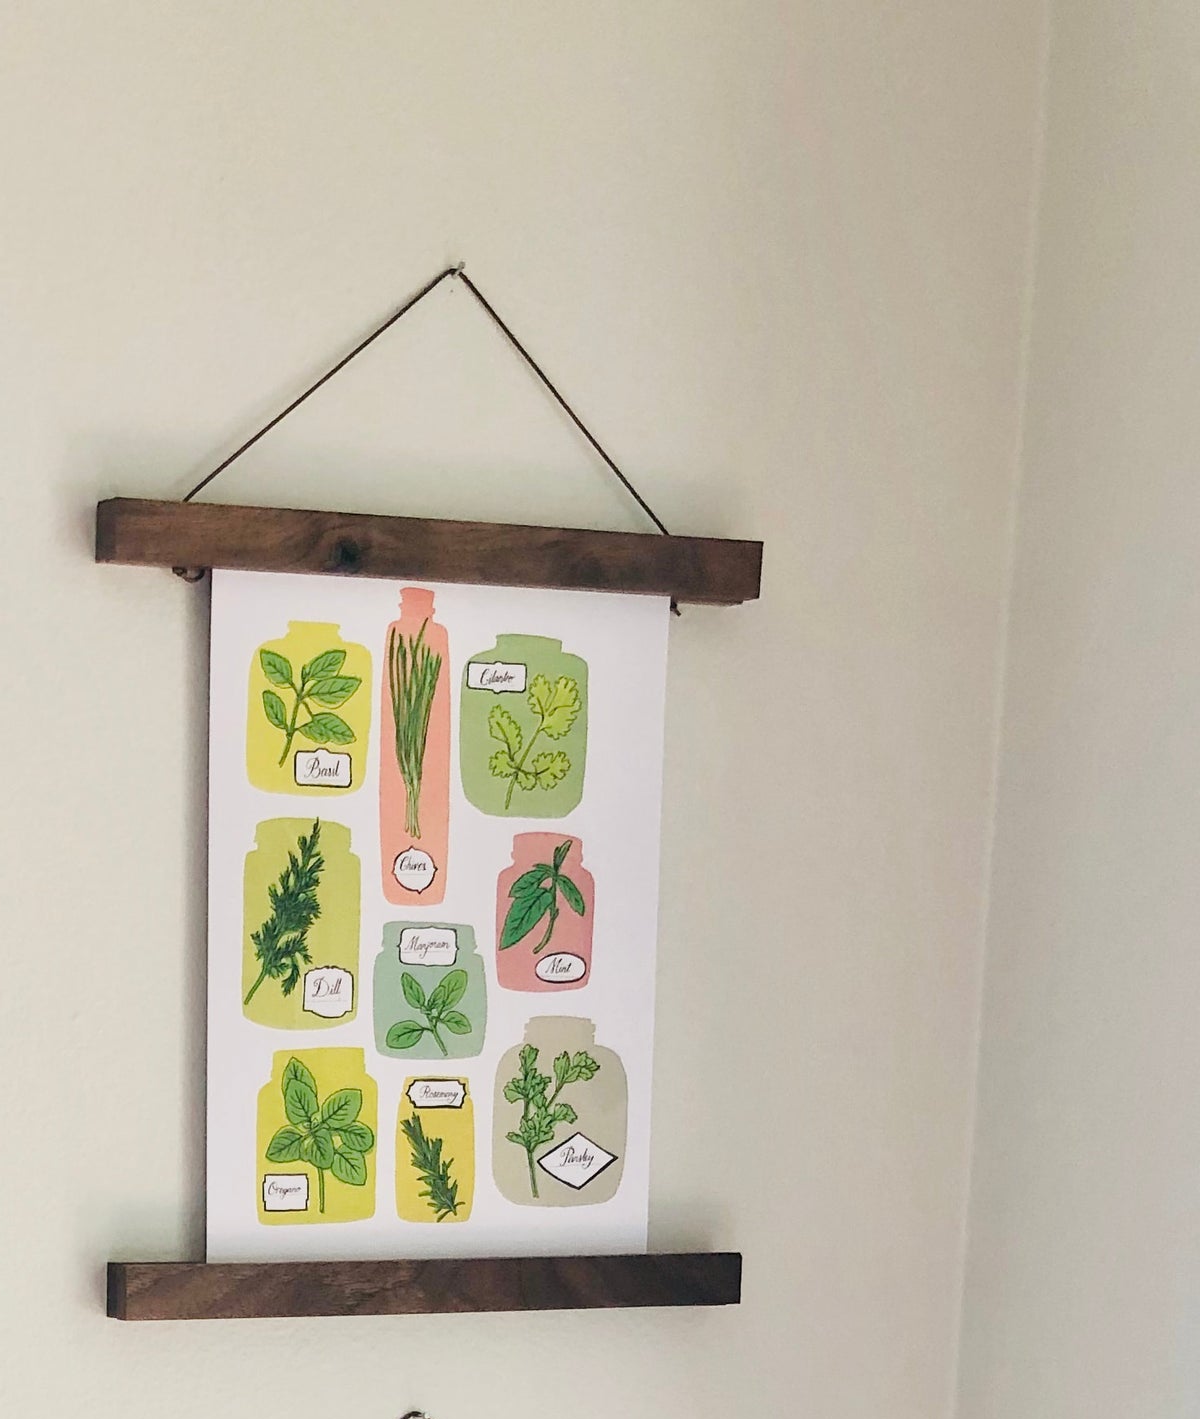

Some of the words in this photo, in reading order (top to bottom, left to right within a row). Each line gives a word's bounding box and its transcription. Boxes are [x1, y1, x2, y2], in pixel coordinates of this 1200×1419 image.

[305, 757, 339, 779] Basil
[400, 856, 427, 872] Chives
[544, 959, 572, 975] Mint
[311, 977, 341, 998] Dill
[559, 1146, 595, 1168] Parsley
